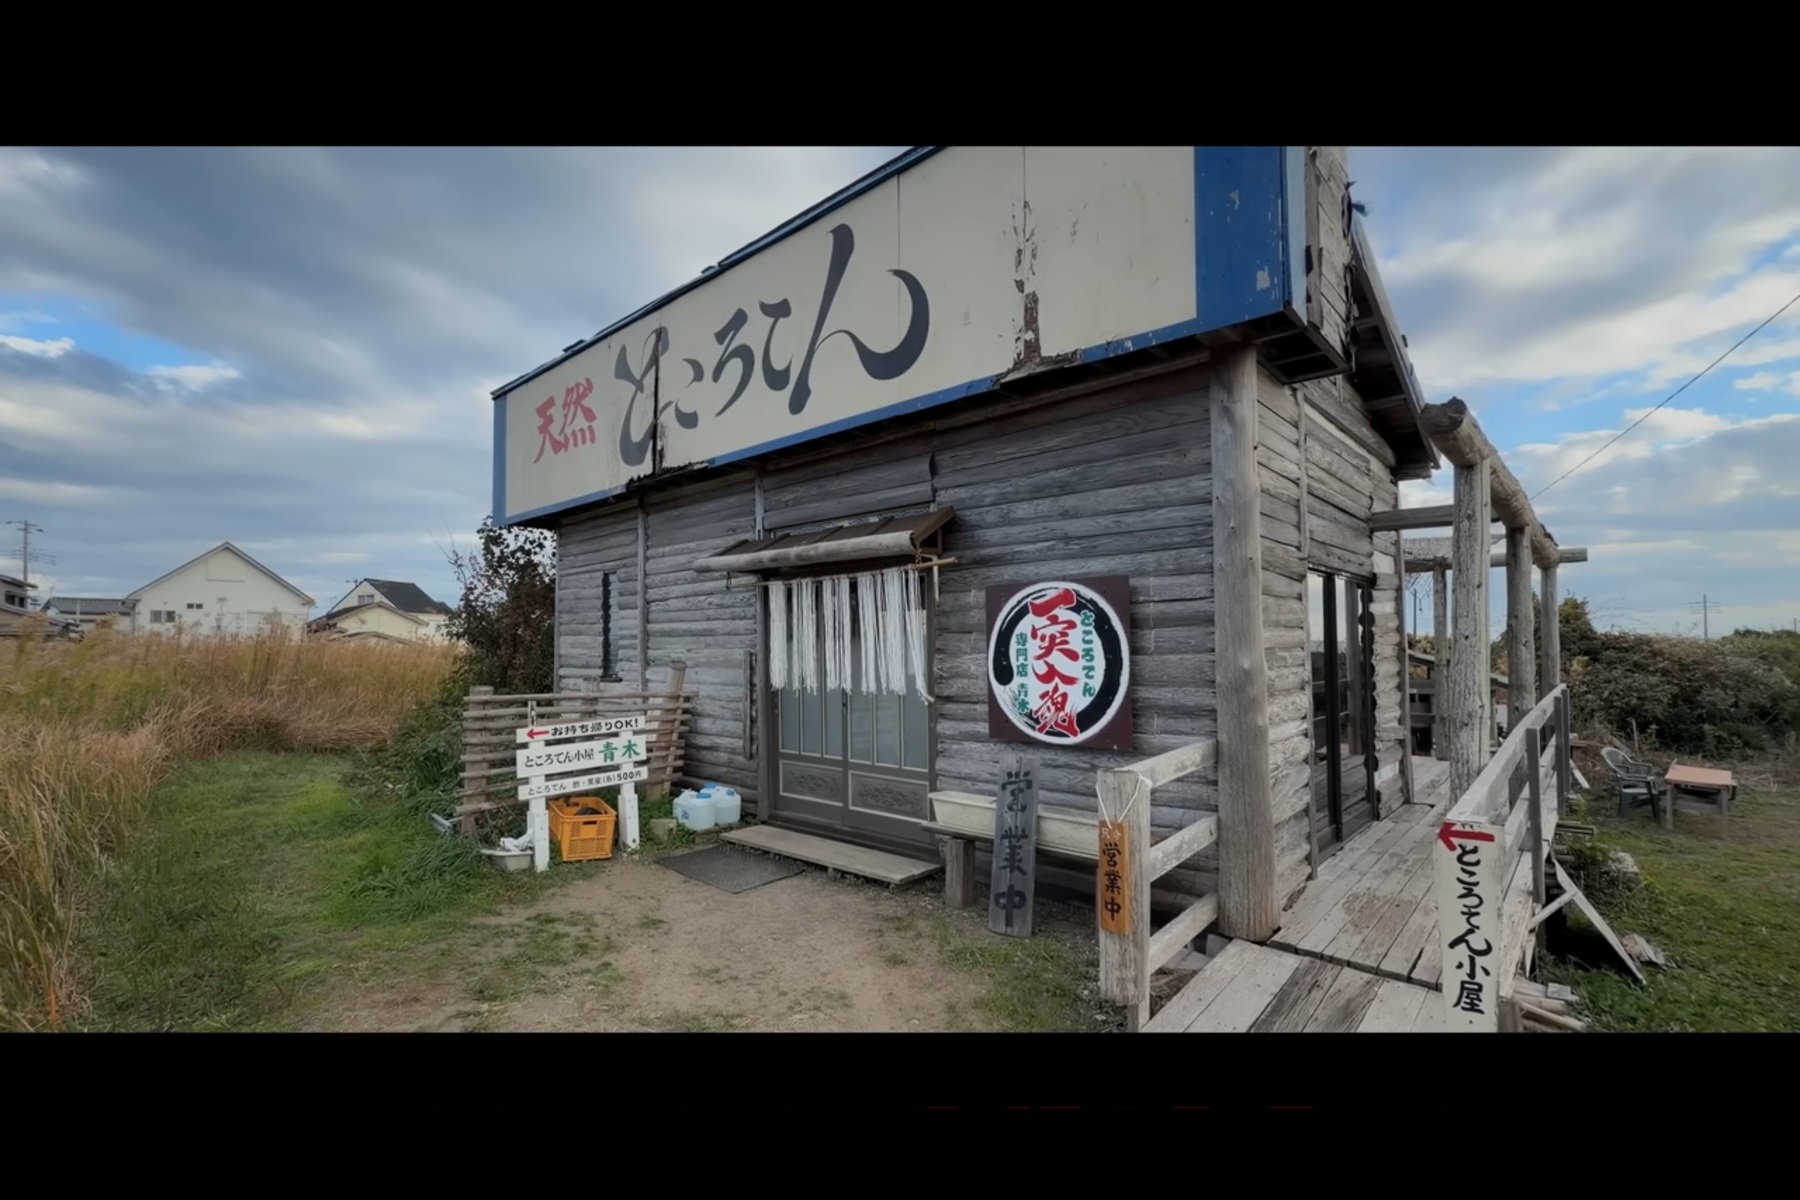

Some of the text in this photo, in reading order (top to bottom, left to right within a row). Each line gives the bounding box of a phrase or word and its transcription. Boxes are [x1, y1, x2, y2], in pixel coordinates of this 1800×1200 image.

[614, 222, 931, 467] ところてん
[533, 377, 597, 464] 天然
[1080, 610, 1096, 698] ところてん
[524, 740, 641, 768] ところてん小屋 青木
[551, 718, 639, 737] お持ち帰りOK!
[528, 781, 567, 796] ところてん
[994, 770, 1033, 928] 営業中
[1102, 842, 1122, 922] 営業中
[1448, 843, 1493, 1015] ところてん小屋
